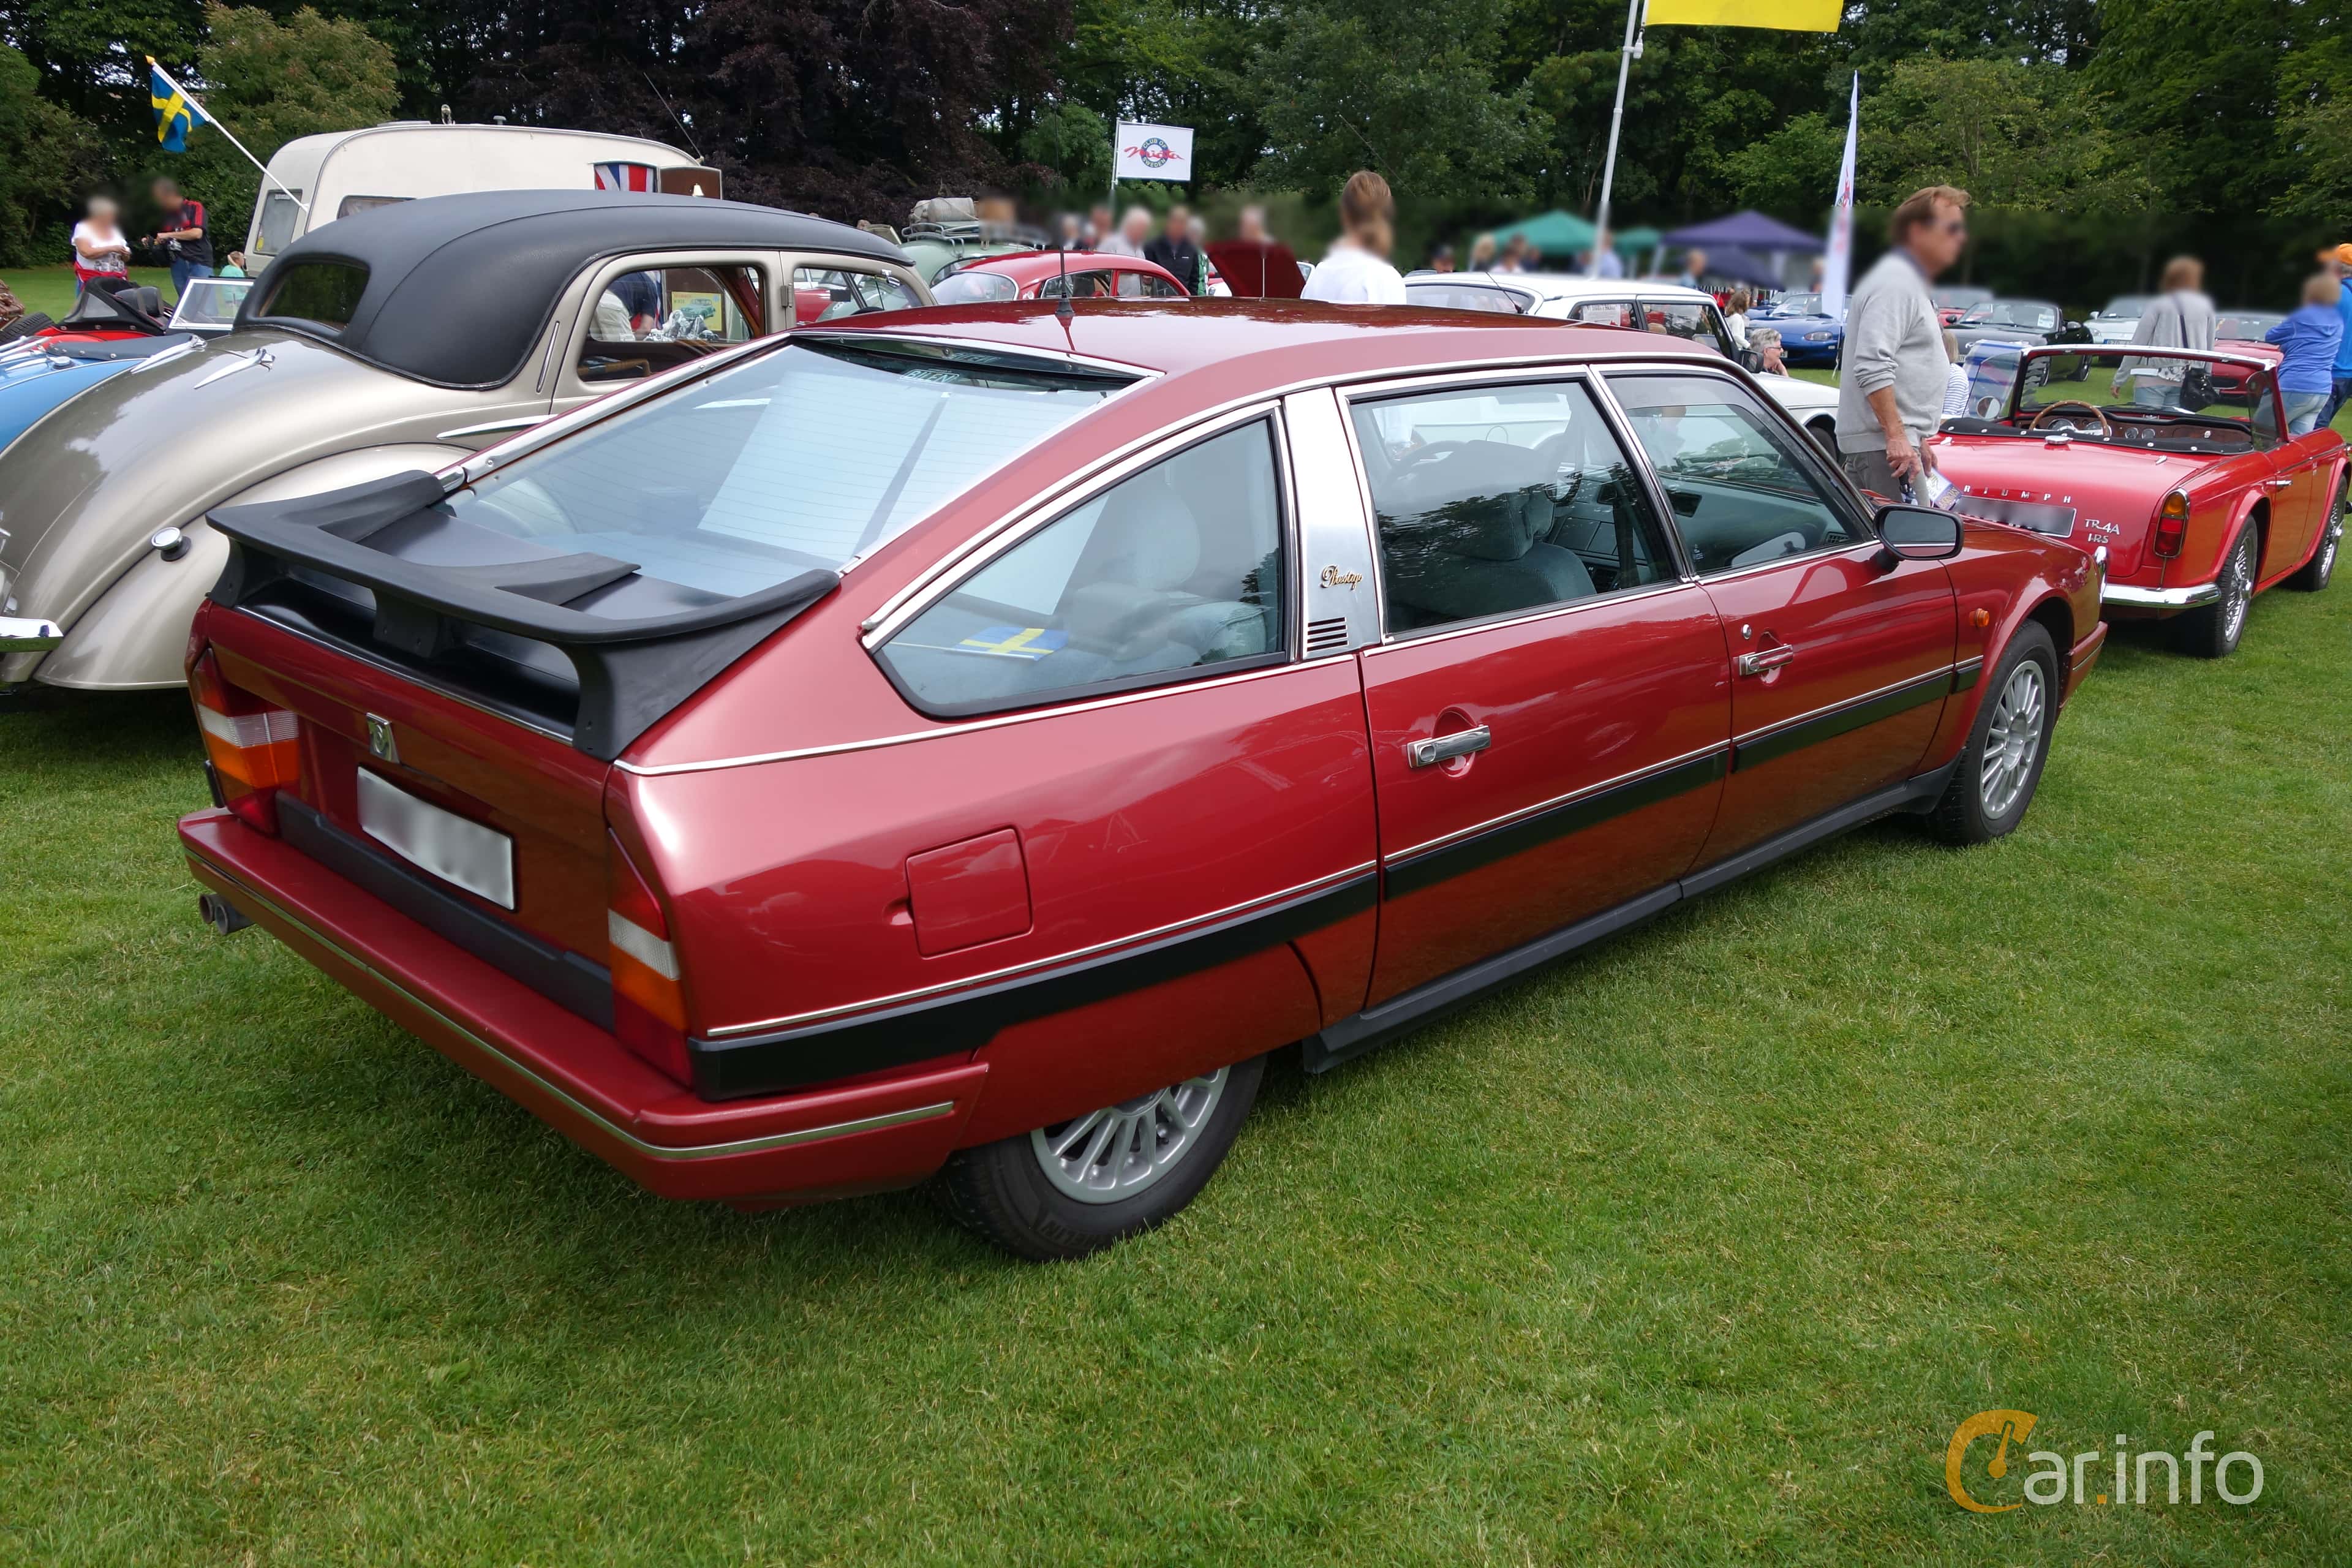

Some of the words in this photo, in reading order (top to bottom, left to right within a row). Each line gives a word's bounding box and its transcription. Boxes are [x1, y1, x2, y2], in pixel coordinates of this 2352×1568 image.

[1143, 138, 1157, 148] CLUB
[1142, 156, 1166, 167] SWEDEN
[1964, 484, 2071, 503] RIUMPH
